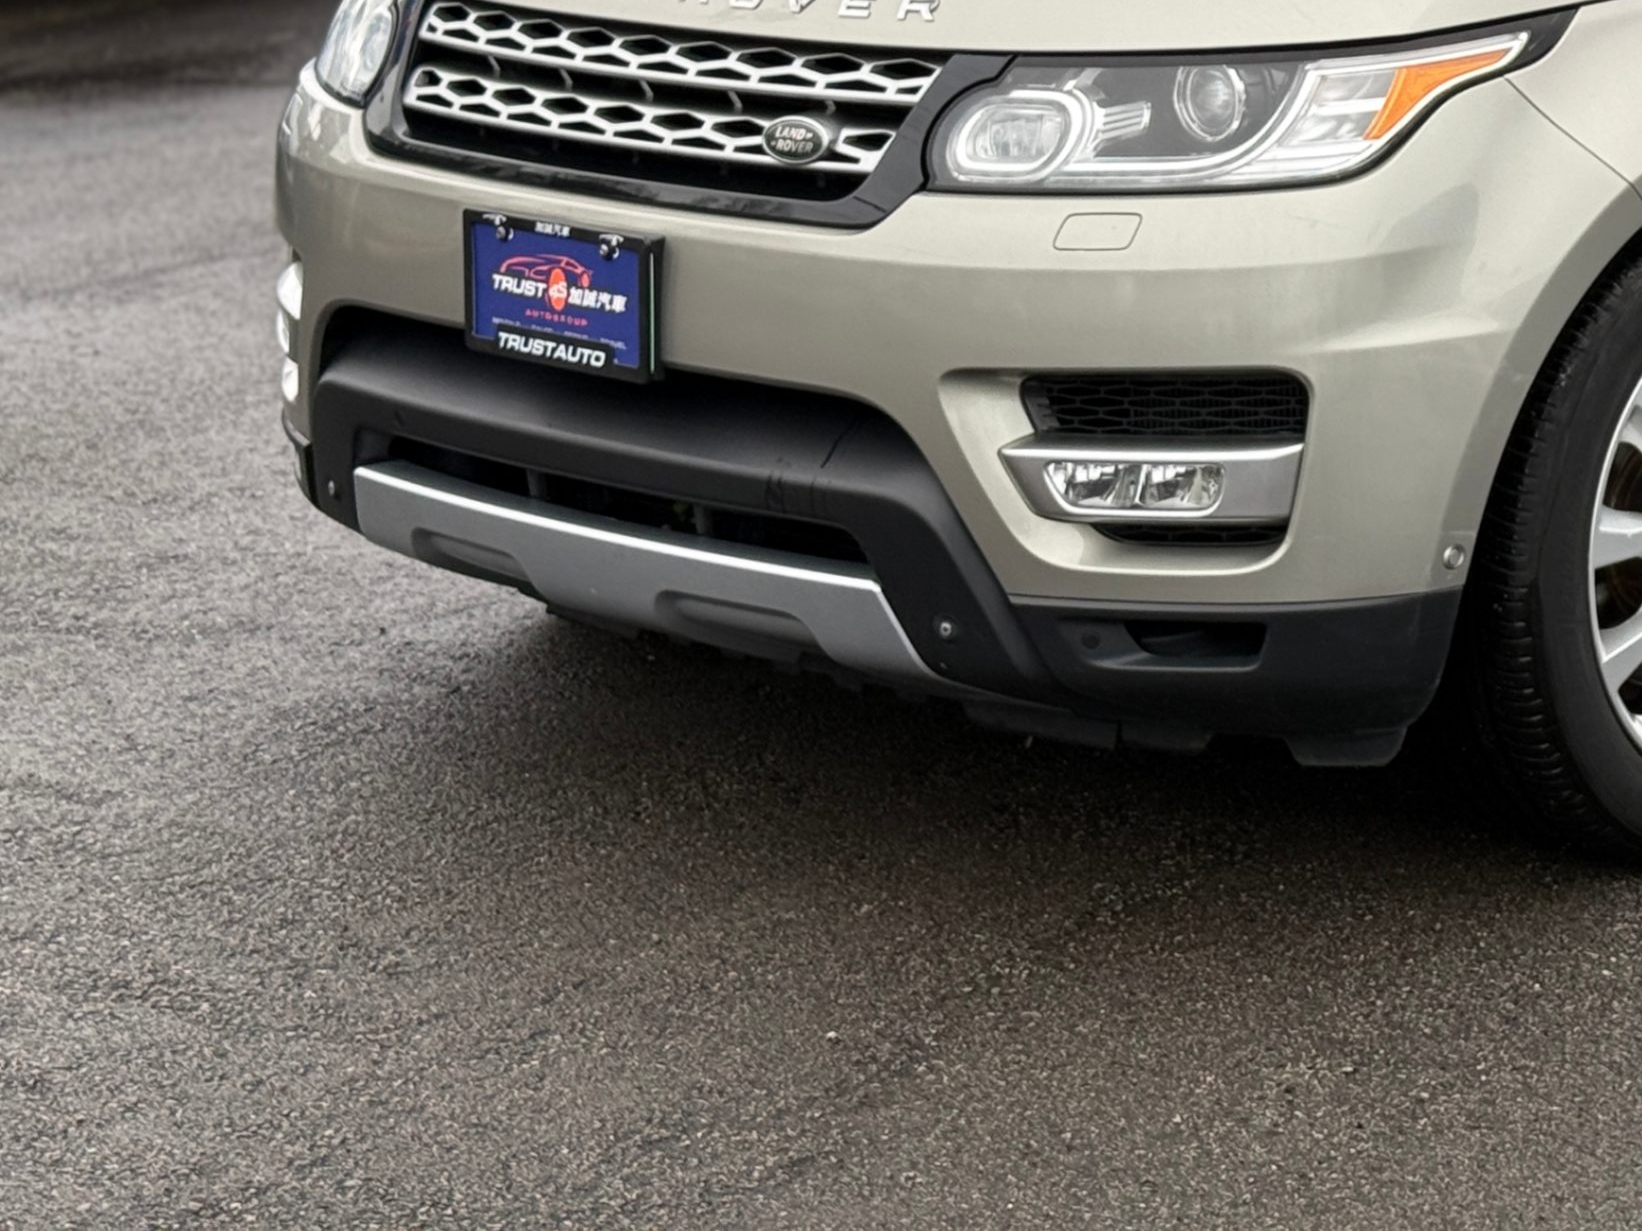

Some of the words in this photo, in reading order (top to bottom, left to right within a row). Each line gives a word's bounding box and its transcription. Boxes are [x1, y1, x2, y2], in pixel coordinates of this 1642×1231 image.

[775, 126, 807, 140] LAND
[775, 138, 814, 154] ROVER
[492, 273, 547, 298] TRUST
[498, 331, 606, 367] TRUSTAUTO
